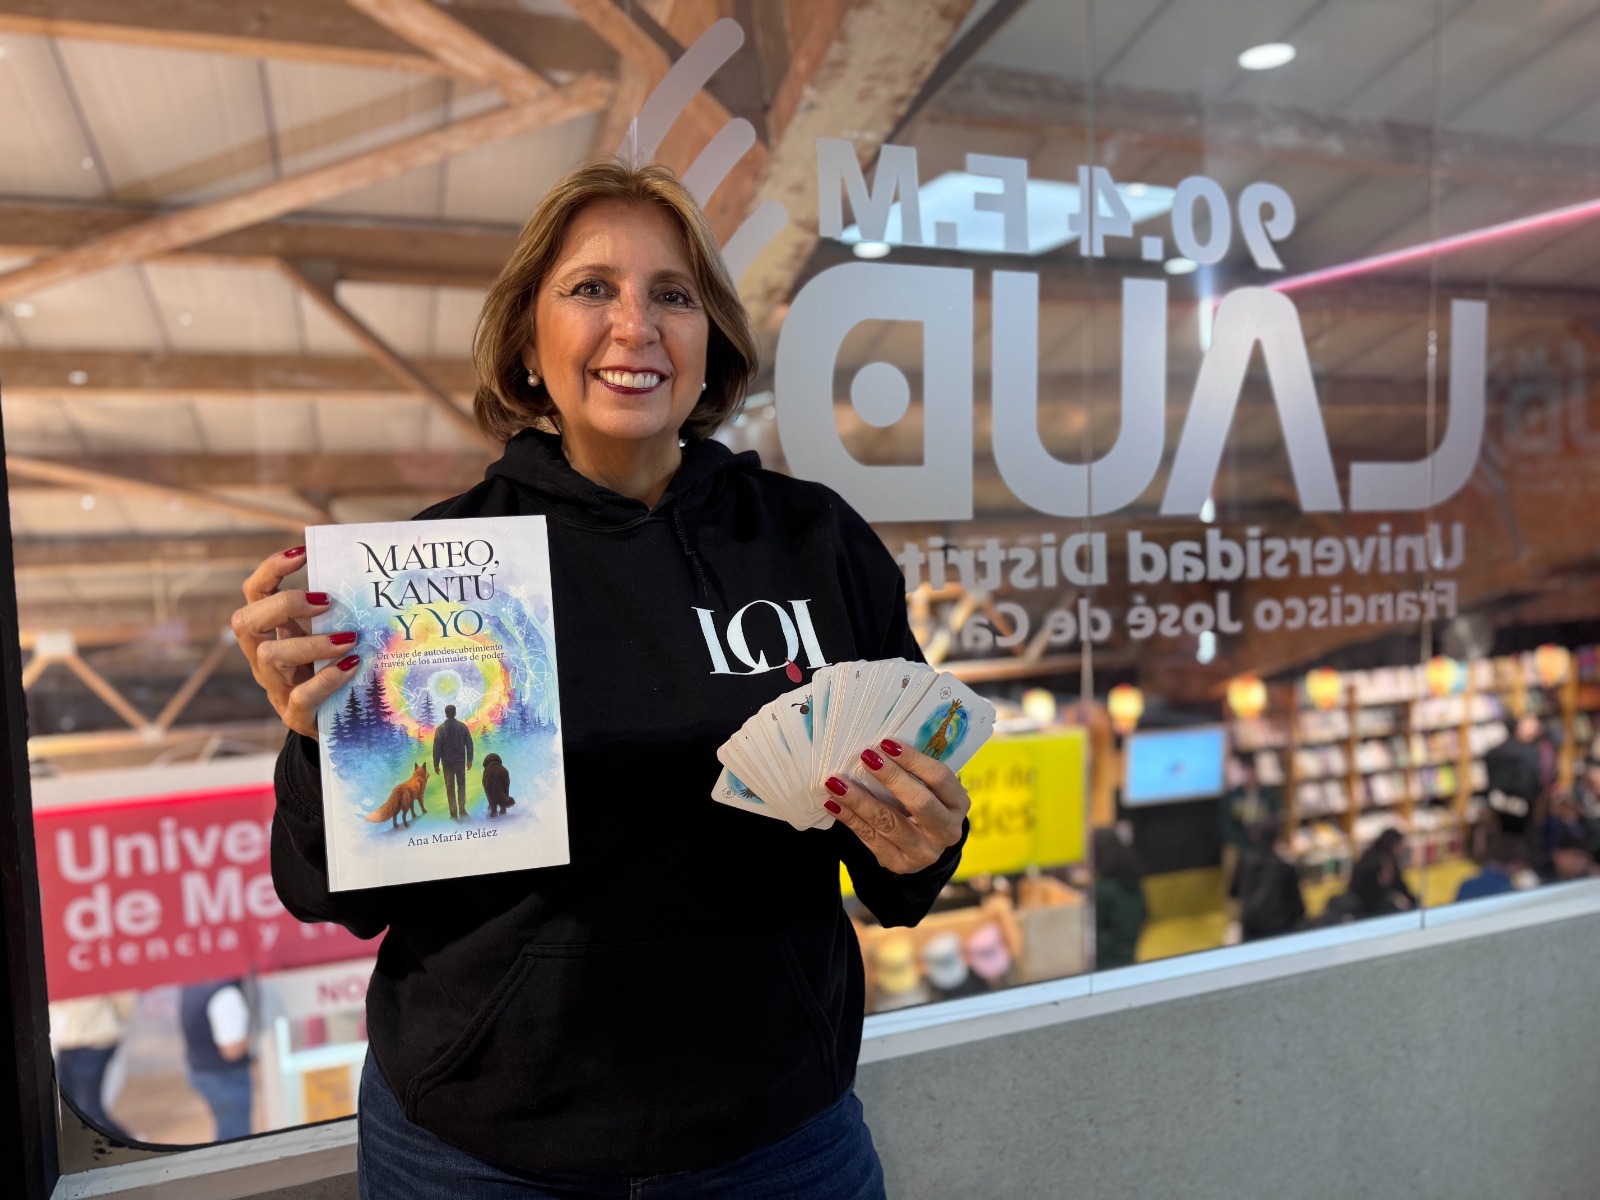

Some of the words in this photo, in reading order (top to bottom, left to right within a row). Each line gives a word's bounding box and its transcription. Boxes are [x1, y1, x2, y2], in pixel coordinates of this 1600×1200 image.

[357, 539, 500, 579] MATEO,
[371, 567, 497, 610] KANTÚ
[393, 613, 420, 641] Y
[424, 607, 484, 639] YO
[376, 652, 389, 660] Un
[391, 651, 410, 661] viaje
[411, 649, 422, 658] de
[423, 644, 503, 657] autodescubrimiento
[381, 658, 405, 668] través
[406, 657, 417, 666] de
[419, 656, 430, 665] los
[432, 653, 468, 664] animales
[469, 652, 480, 661] de
[481, 650, 507, 662] poder.
[55, 816, 275, 885] Unive
[407, 837, 429, 847] Ana
[432, 830, 463, 844] María
[465, 827, 498, 840] Peláez
[63, 882, 163, 943] de
[181, 867, 286, 928] Me
[67, 926, 239, 973] Ciencia
